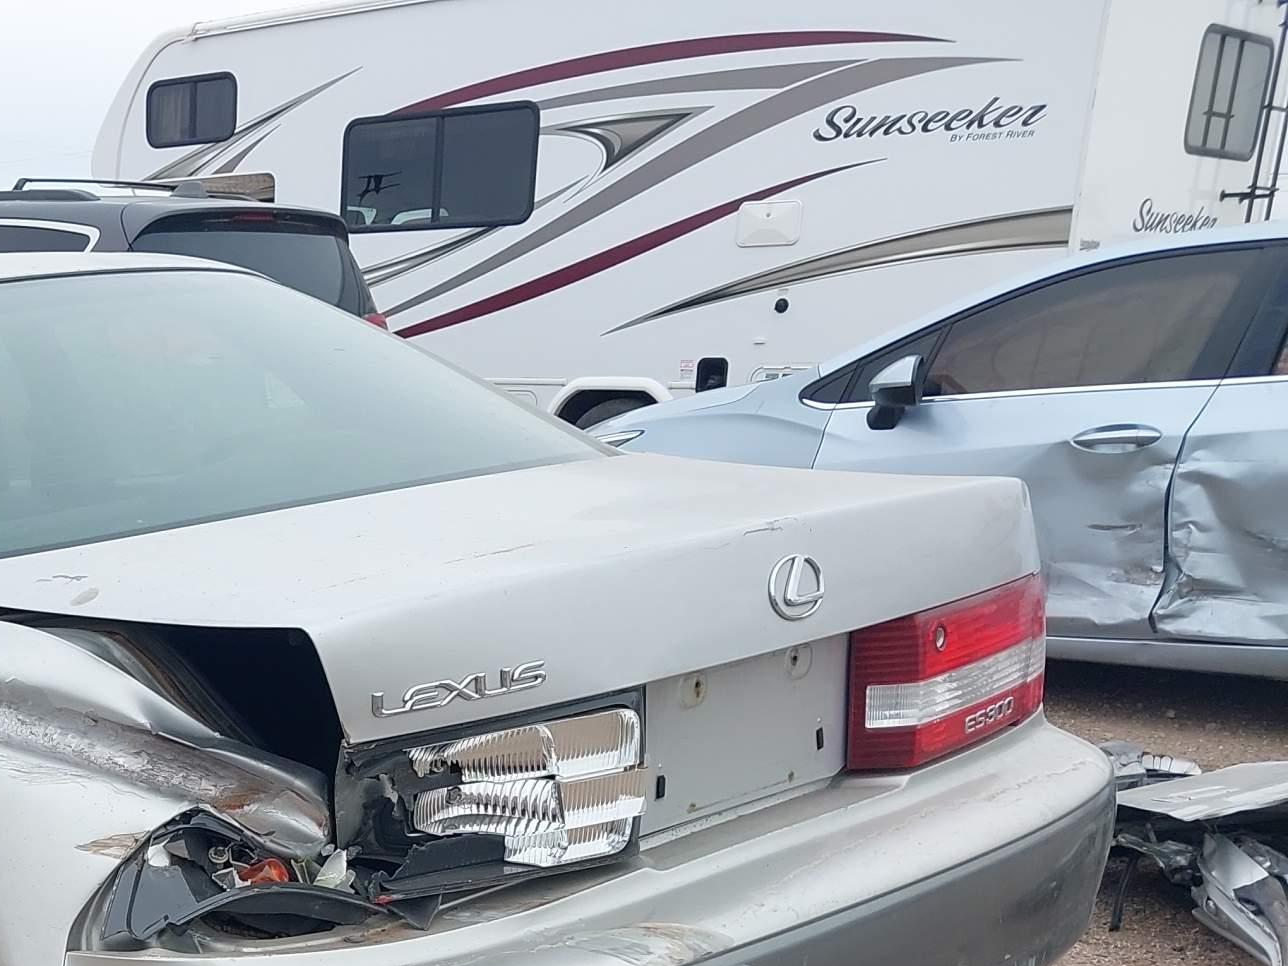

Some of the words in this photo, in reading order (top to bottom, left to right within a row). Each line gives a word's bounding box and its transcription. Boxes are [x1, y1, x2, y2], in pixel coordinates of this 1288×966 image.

[812, 97, 1047, 142] Sunseeker
[966, 131, 1003, 141] FOREST
[1006, 130, 1034, 139] RIVER
[1132, 198, 1218, 234] Sunseeker
[371, 659, 546, 718] LEXUS
[965, 696, 1014, 734] ES300
